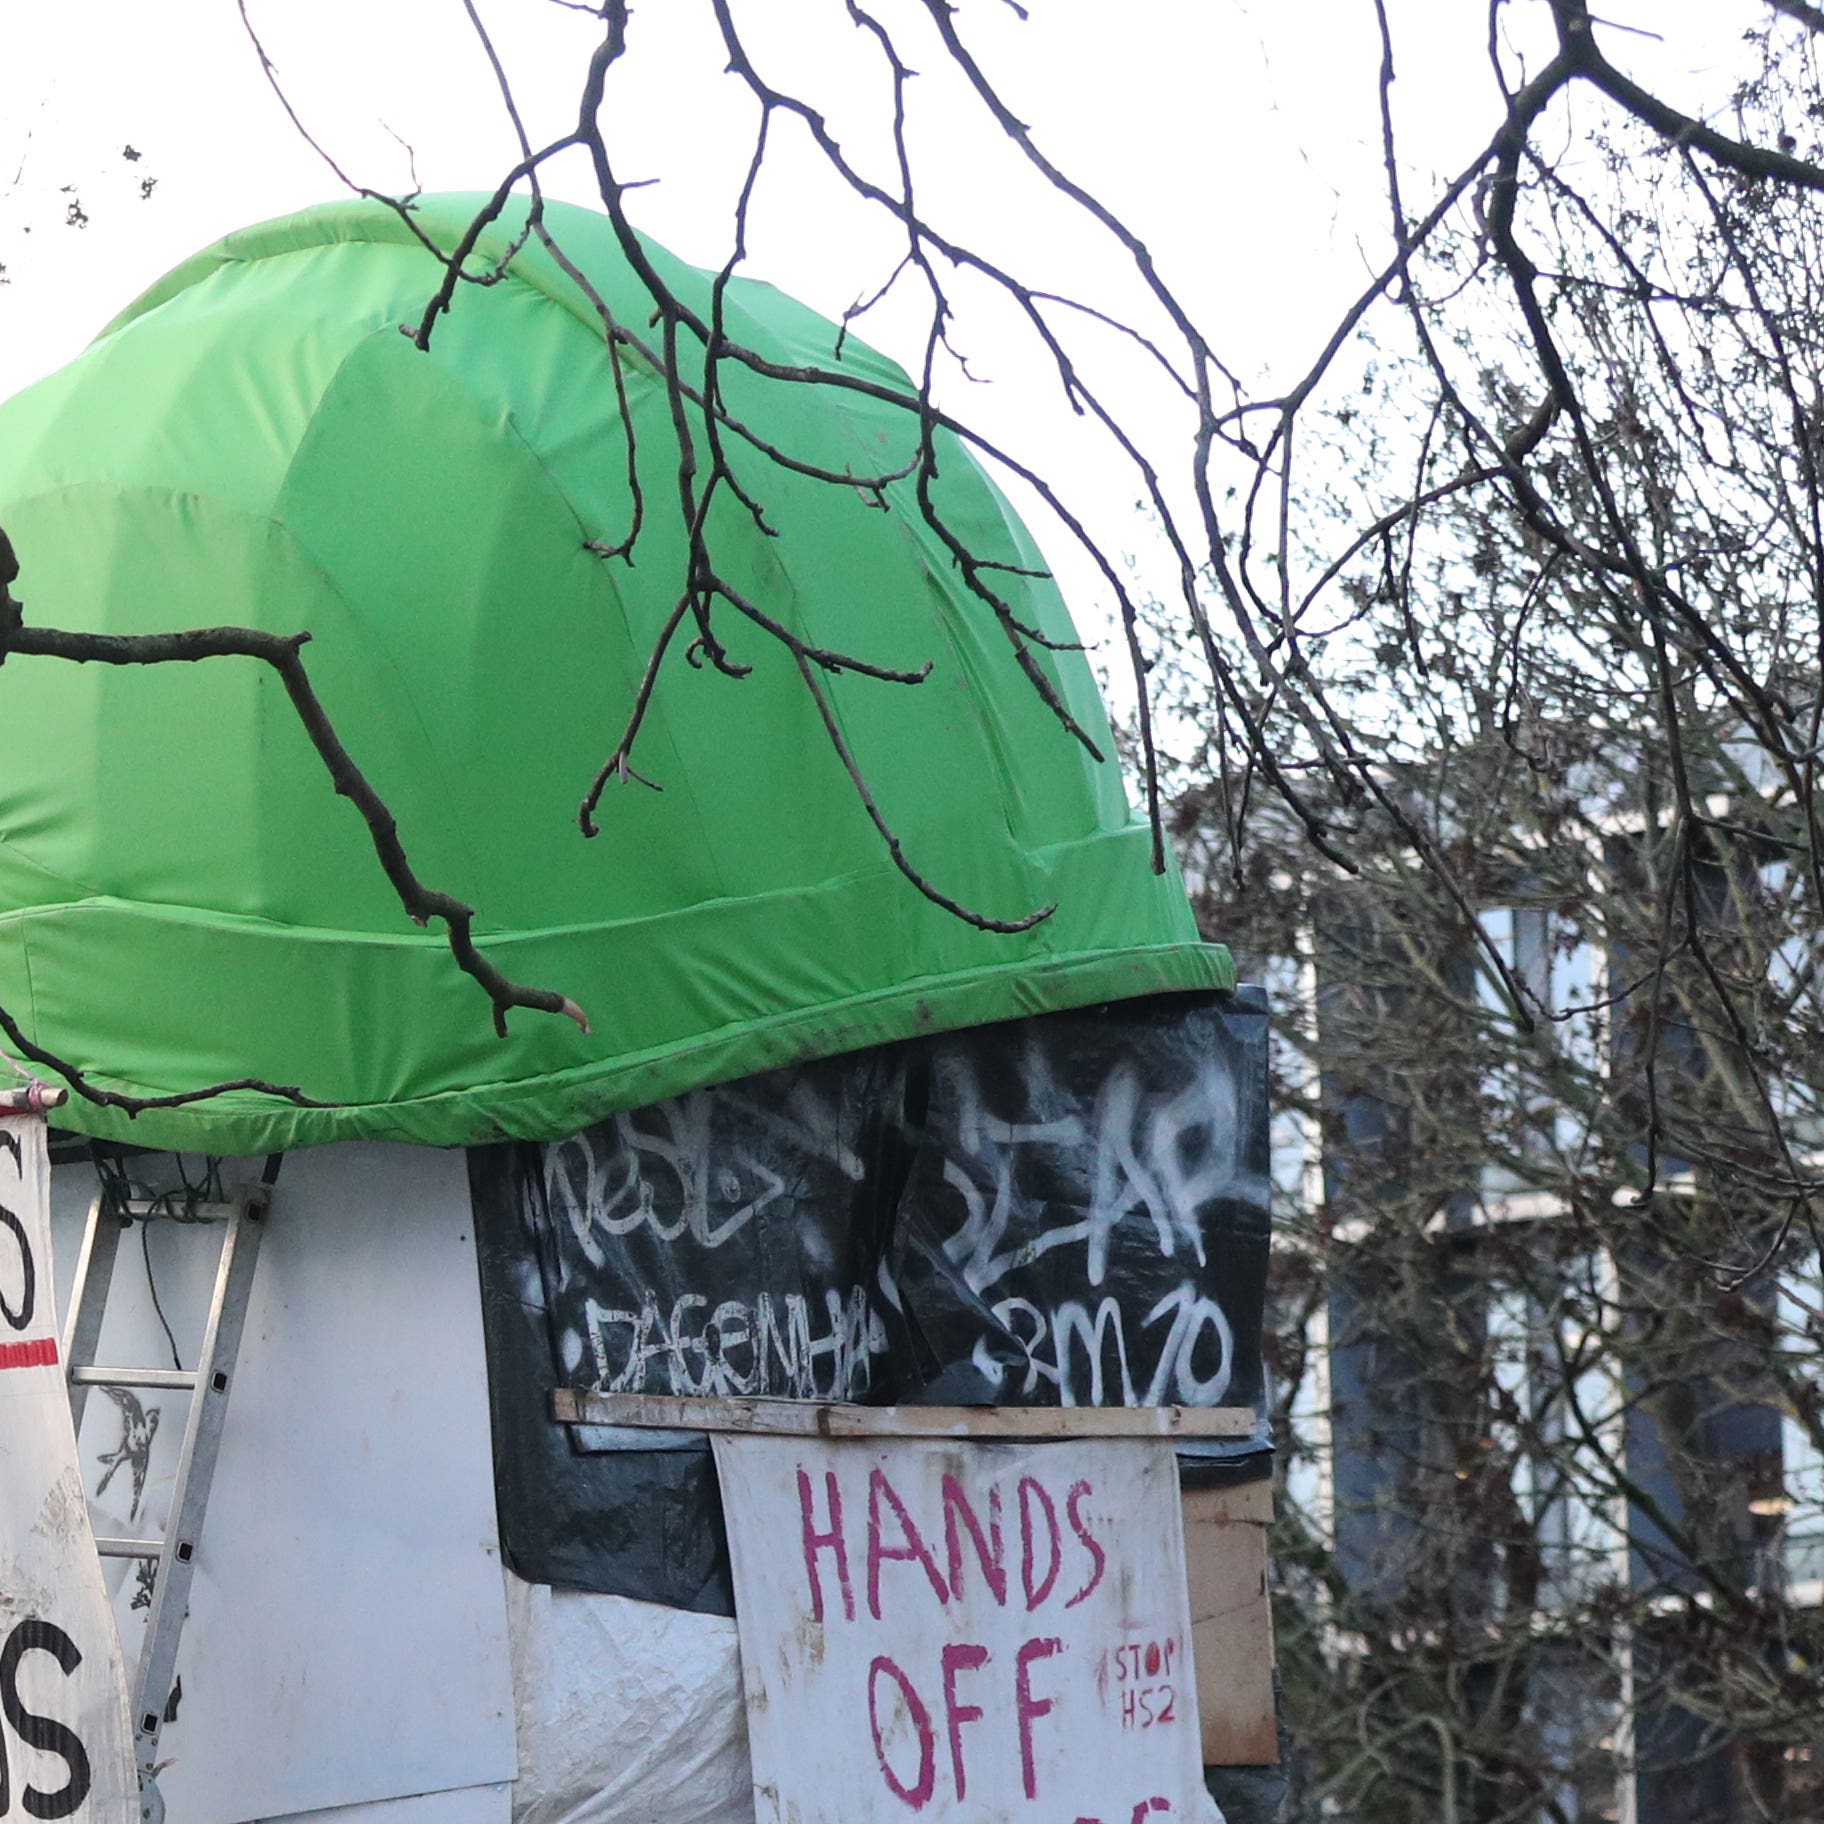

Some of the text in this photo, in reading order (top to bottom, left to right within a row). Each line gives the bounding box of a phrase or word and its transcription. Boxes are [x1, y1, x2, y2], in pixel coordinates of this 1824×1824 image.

[796, 1464, 1106, 1624] HANDS
[1114, 1636, 1175, 1682] STOP
[1120, 1685, 1176, 1729] HS2
[868, 1636, 1068, 1813] OFF
